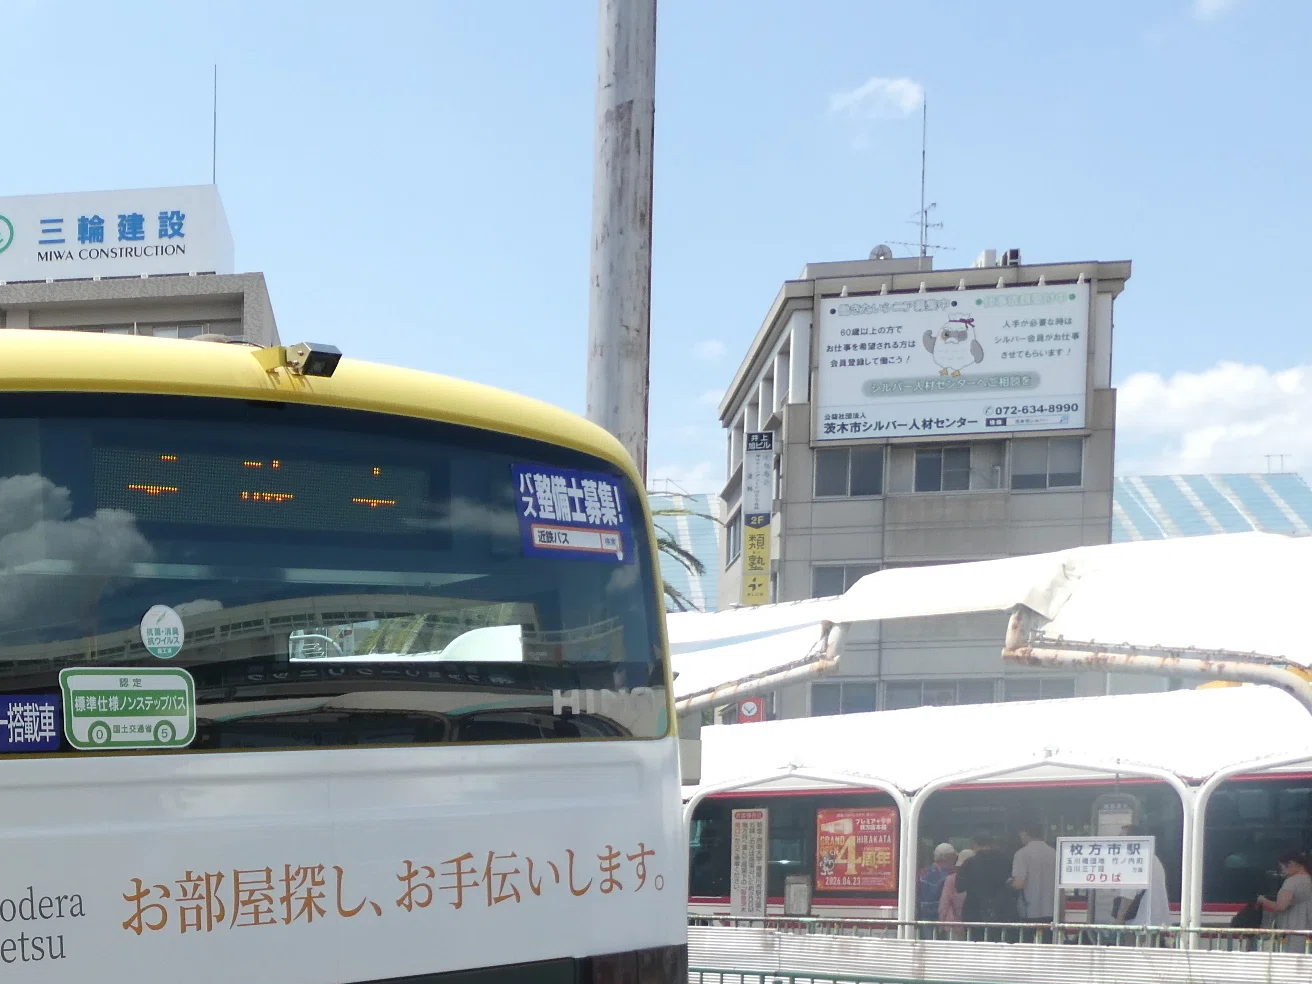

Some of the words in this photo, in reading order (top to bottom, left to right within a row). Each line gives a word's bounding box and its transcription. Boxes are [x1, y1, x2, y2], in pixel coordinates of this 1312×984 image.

[38, 210, 186, 245] 三輪建設
[38, 249, 74, 262] MIWA
[78, 244, 186, 260] CONSTRUCTION
[826, 340, 916, 353] お仕事を希望される方は
[871, 376, 1031, 394] シルバー人材センターへご相談を
[995, 403, 1079, 416] 072-634-8990
[823, 417, 978, 435] 茨木市シルバー人材センター
[751, 516, 764, 525] 2F
[537, 530, 569, 544] 近鉄バス
[147, 636, 180, 646] 抗ウイルス
[74, 695, 186, 712] 標準仕様ノンステップバス
[112, 724, 152, 734] 国土交通省
[161, 728, 169, 739] 5
[856, 835, 892, 844] HIRAKATA
[1069, 843, 1141, 856] 枚方市駅
[1086, 873, 1122, 883] のりば
[121, 842, 666, 935] お部屋探し、お手伝いします。
